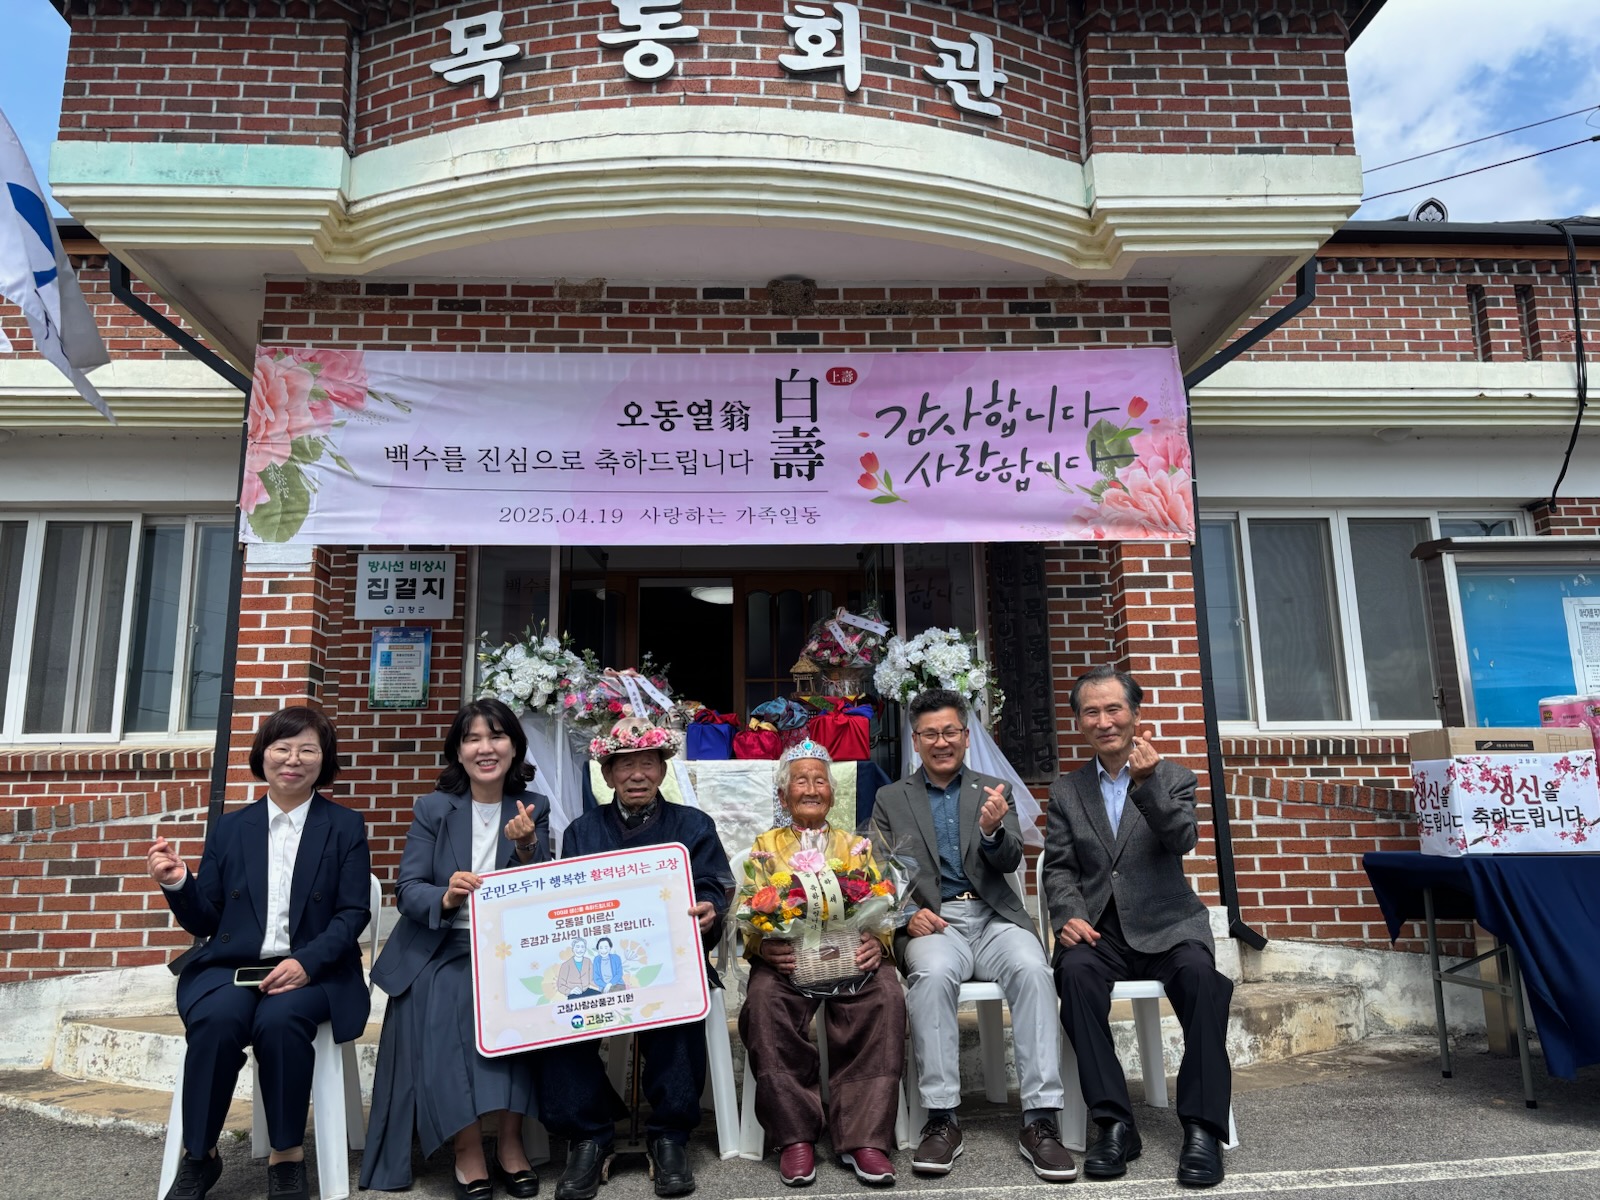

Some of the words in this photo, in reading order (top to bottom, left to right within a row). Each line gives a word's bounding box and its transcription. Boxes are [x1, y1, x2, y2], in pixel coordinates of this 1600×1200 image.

[430, 0, 1009, 119] 목동회관
[875, 379, 1121, 446] 감사합니다
[384, 445, 468, 475] 백수를
[477, 447, 586, 474] 진심으로
[594, 449, 754, 477] 축하드립니다
[904, 439, 1140, 492] 사랑합니다
[499, 506, 623, 525] 2025.04.19
[639, 506, 727, 526] 사랑하는
[735, 506, 822, 526] 가족일동
[368, 560, 404, 573] 방사선
[410, 560, 446, 573] 비상시
[367, 577, 445, 600] 집결지
[398, 606, 425, 614] 고창군
[1414, 780, 1450, 810] 생신을
[1490, 773, 1560, 806] 생신을
[1471, 806, 1583, 830] 축하드립니다
[480, 877, 546, 900] 군민모두가
[549, 871, 587, 888] 행복한
[590, 861, 652, 882] 활력넘치는
[655, 857, 680, 872] 고창
[586, 911, 615, 924] 어르신
[520, 935, 549, 949] 존경과
[551, 929, 581, 943] 감사의
[583, 924, 611, 938] 마음을
[614, 917, 655, 934] 전합니다.
[617, 993, 634, 1004] 지원
[586, 1012, 614, 1026] 고창군
